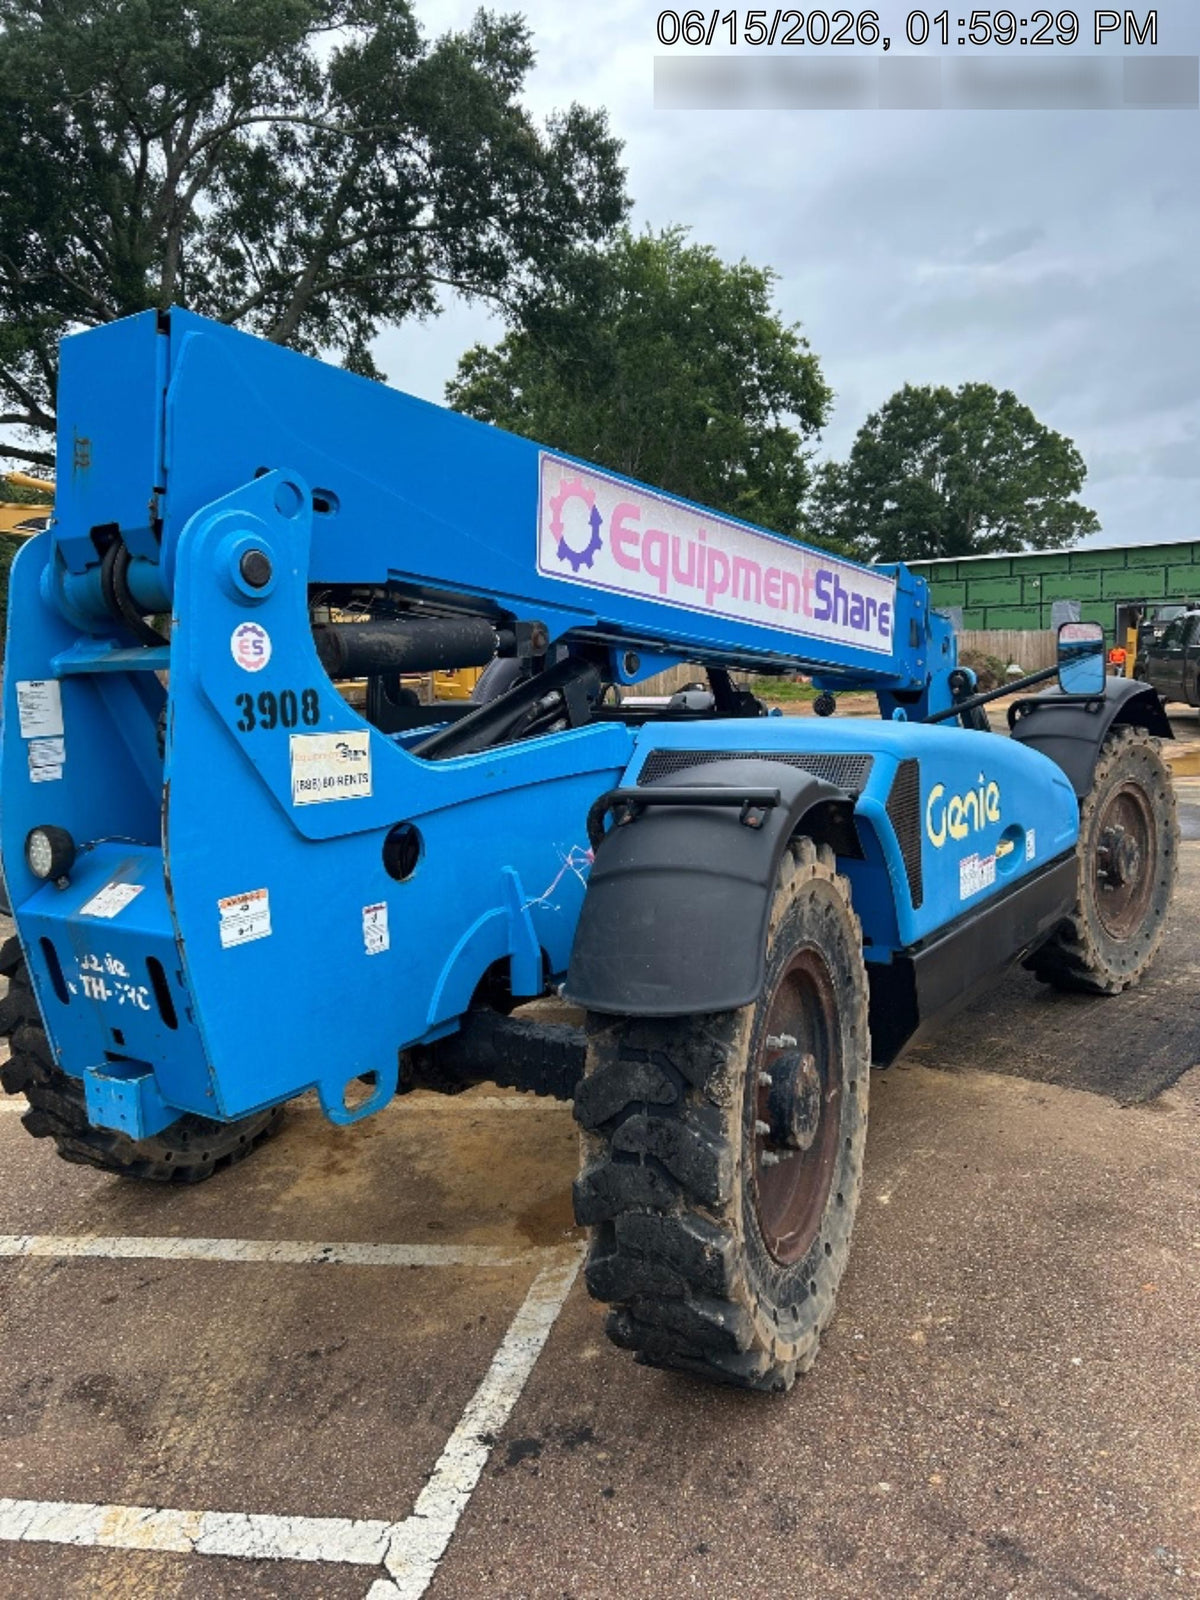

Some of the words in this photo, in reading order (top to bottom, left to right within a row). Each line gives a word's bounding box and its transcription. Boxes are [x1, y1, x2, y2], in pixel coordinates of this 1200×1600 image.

[609, 502, 891, 637] EquipmentShare
[238, 638, 264, 655] ES
[235, 688, 320, 732] 3908
[925, 769, 1001, 849] Genie
